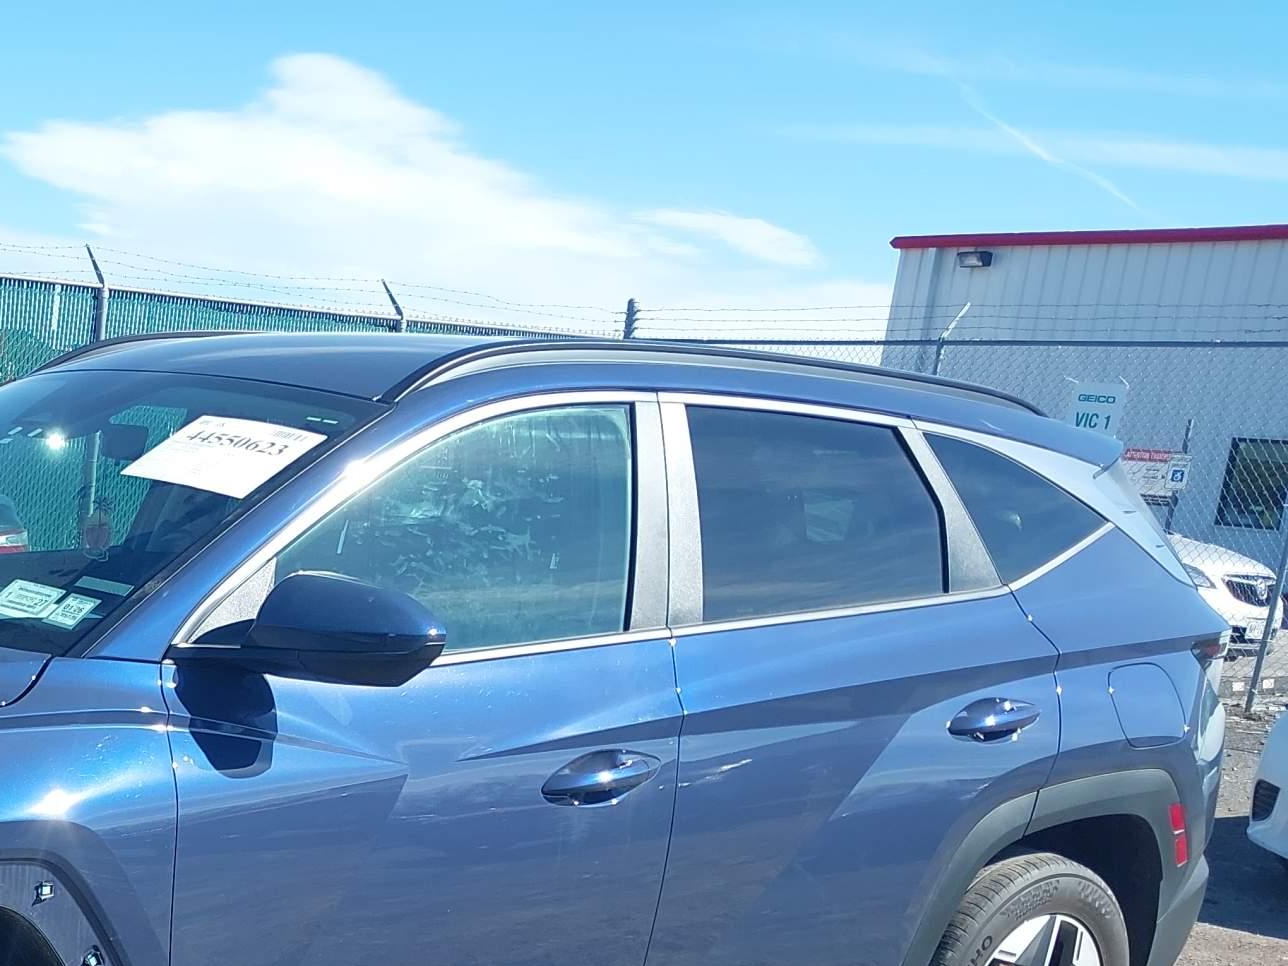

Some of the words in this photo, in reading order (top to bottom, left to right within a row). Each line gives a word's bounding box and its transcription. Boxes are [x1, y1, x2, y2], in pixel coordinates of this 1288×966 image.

[1078, 393, 1116, 404] GEICO
[1075, 411, 1099, 429] VIC
[1104, 415, 1111, 430] 1
[185, 429, 289, 456] 44550623
